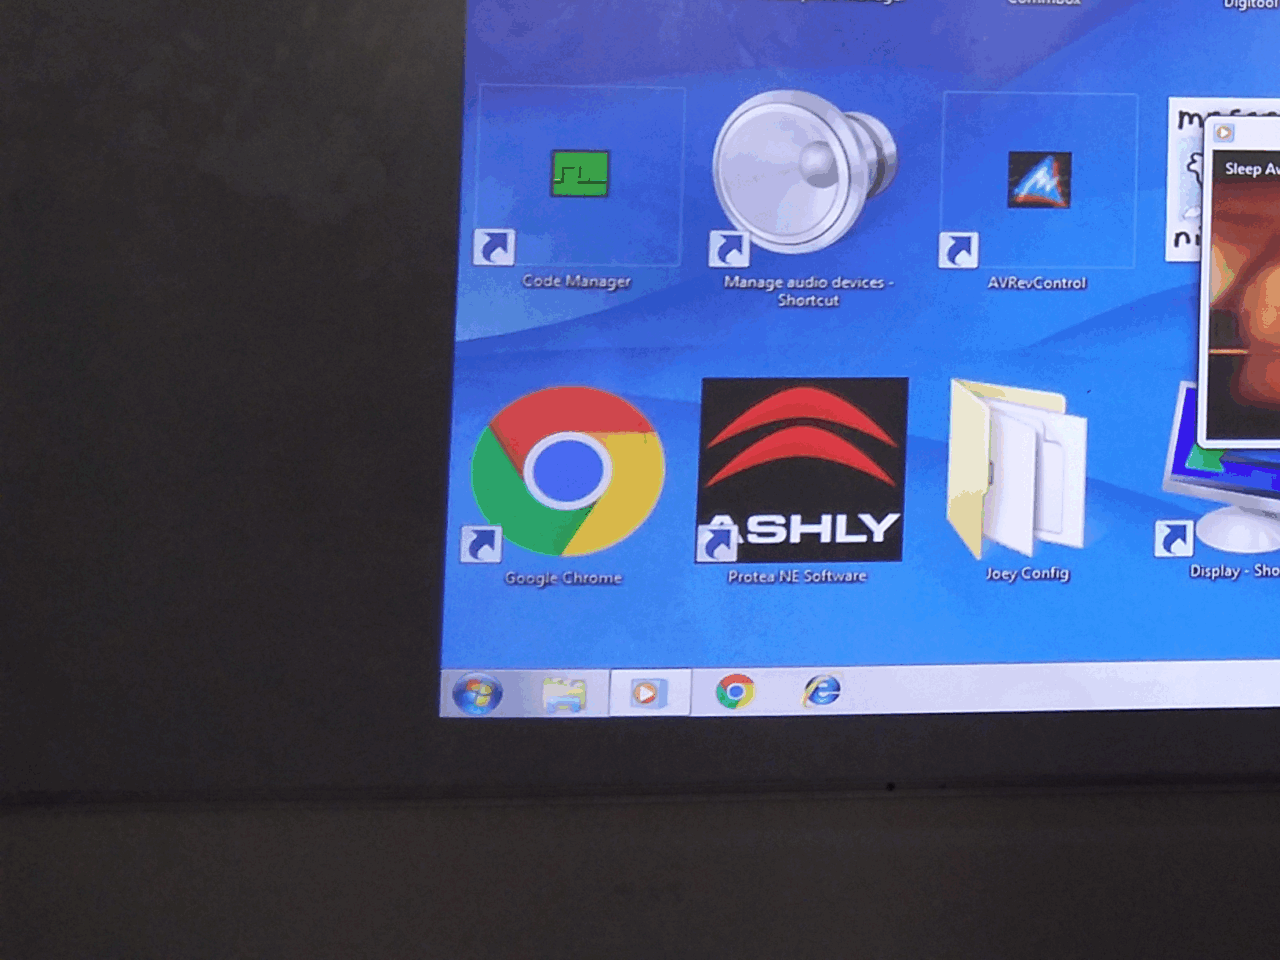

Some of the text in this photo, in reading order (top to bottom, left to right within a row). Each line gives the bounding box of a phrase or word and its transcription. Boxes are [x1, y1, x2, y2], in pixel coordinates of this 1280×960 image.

[1225, 162, 1262, 177] Sleep
[522, 275, 632, 291] Code Manager
[724, 276, 783, 291] Manage
[787, 276, 828, 289] audio
[832, 276, 884, 289] devices
[987, 277, 1087, 290] AVRevControl
[778, 294, 839, 307] Shortcut
[505, 571, 623, 587] Google Chrome
[728, 569, 867, 583] Protea NE Software
[986, 567, 1070, 582] Joey Config
[1191, 564, 1240, 580] Display
